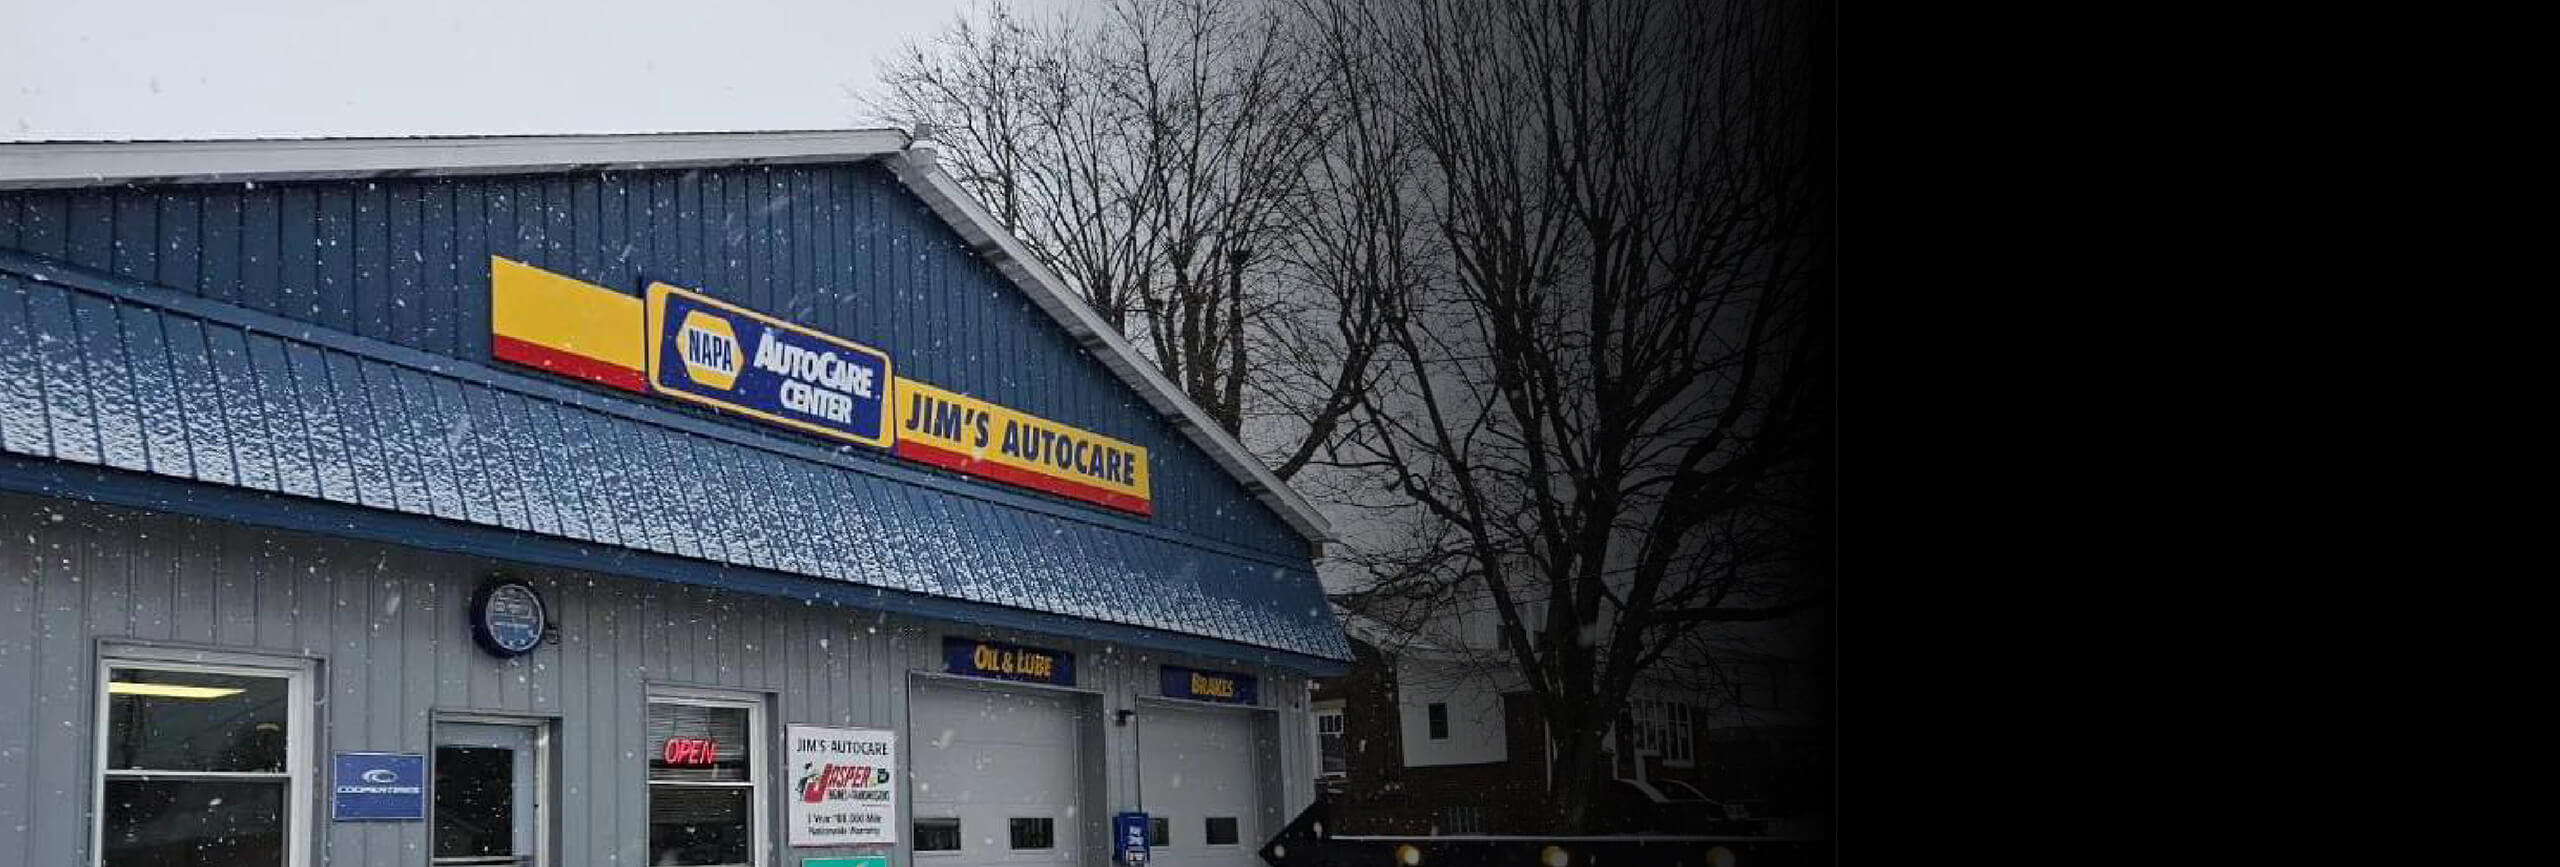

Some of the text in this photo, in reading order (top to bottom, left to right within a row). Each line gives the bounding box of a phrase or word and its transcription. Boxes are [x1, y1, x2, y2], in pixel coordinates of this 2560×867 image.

[689, 328, 733, 374] NAPA
[781, 381, 853, 425] CENTER
[905, 391, 1136, 487] JIM'S AUTOCARE
[665, 738, 716, 765] OPEN
[797, 739, 888, 755] JIM'S AUTOCARE
